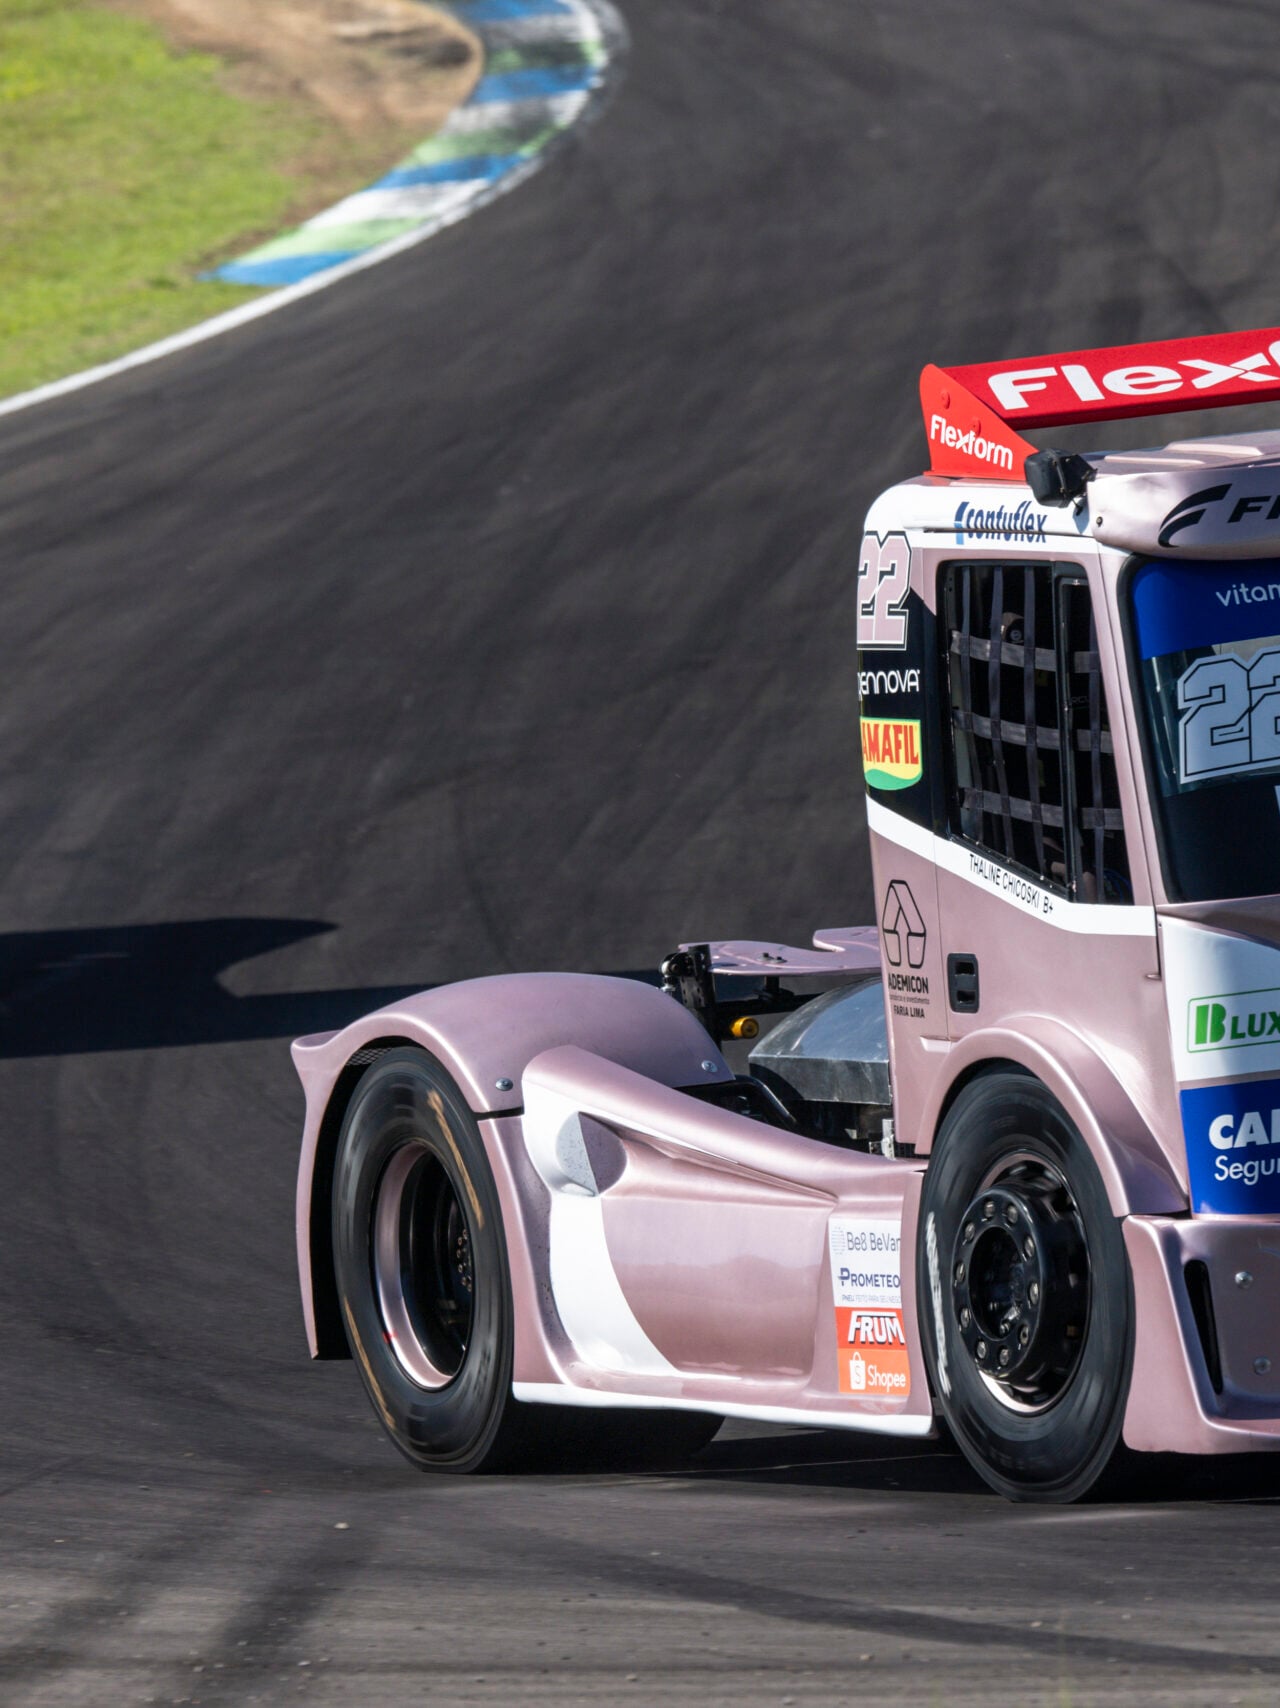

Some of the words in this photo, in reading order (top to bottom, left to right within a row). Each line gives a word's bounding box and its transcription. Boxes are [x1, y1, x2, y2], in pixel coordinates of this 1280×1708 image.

[930, 414, 1013, 470] Flexform
[966, 501, 1048, 543] contuflex
[857, 531, 911, 650] 22
[861, 722, 919, 765] AMAFIL
[970, 853, 1001, 886] THALINE
[1002, 872, 1041, 909] CHICOSKI
[1042, 896, 1054, 914] B+
[888, 972, 929, 994] ADEMICON
[894, 1005, 909, 1017] FARIA
[910, 1006, 925, 1019] LIMA
[846, 1231, 867, 1252] Be8
[848, 1311, 905, 1345] FRUM
[868, 1364, 906, 1392] Shopee
